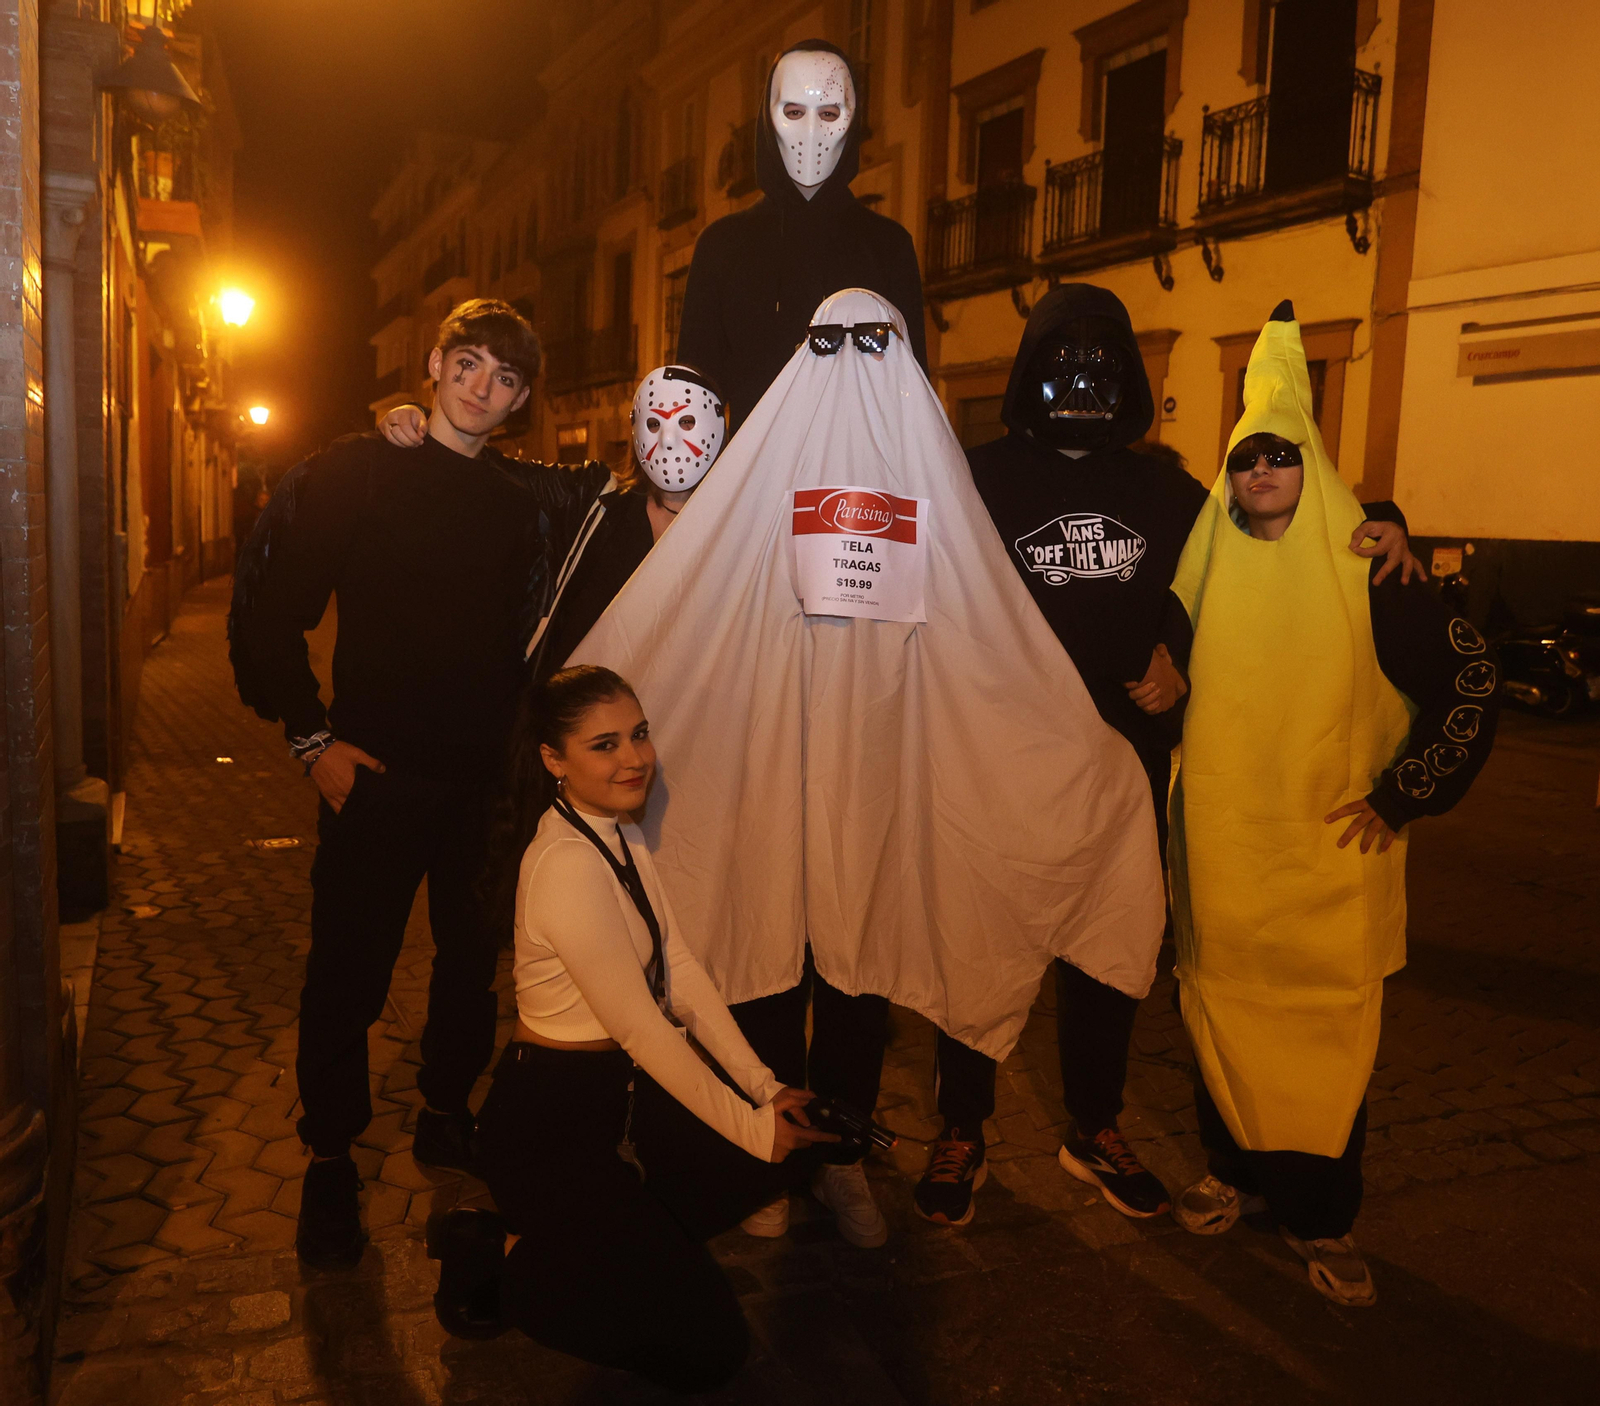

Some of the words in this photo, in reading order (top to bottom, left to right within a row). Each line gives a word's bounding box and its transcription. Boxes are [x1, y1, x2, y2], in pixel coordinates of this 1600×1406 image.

[834, 498, 891, 523] Parisina
[1059, 518, 1105, 541] VANS
[841, 540, 874, 554] TELA
[1066, 541, 1099, 570] THE
[833, 558, 882, 573] TRAGAS
[836, 578, 873, 590] $19.99
